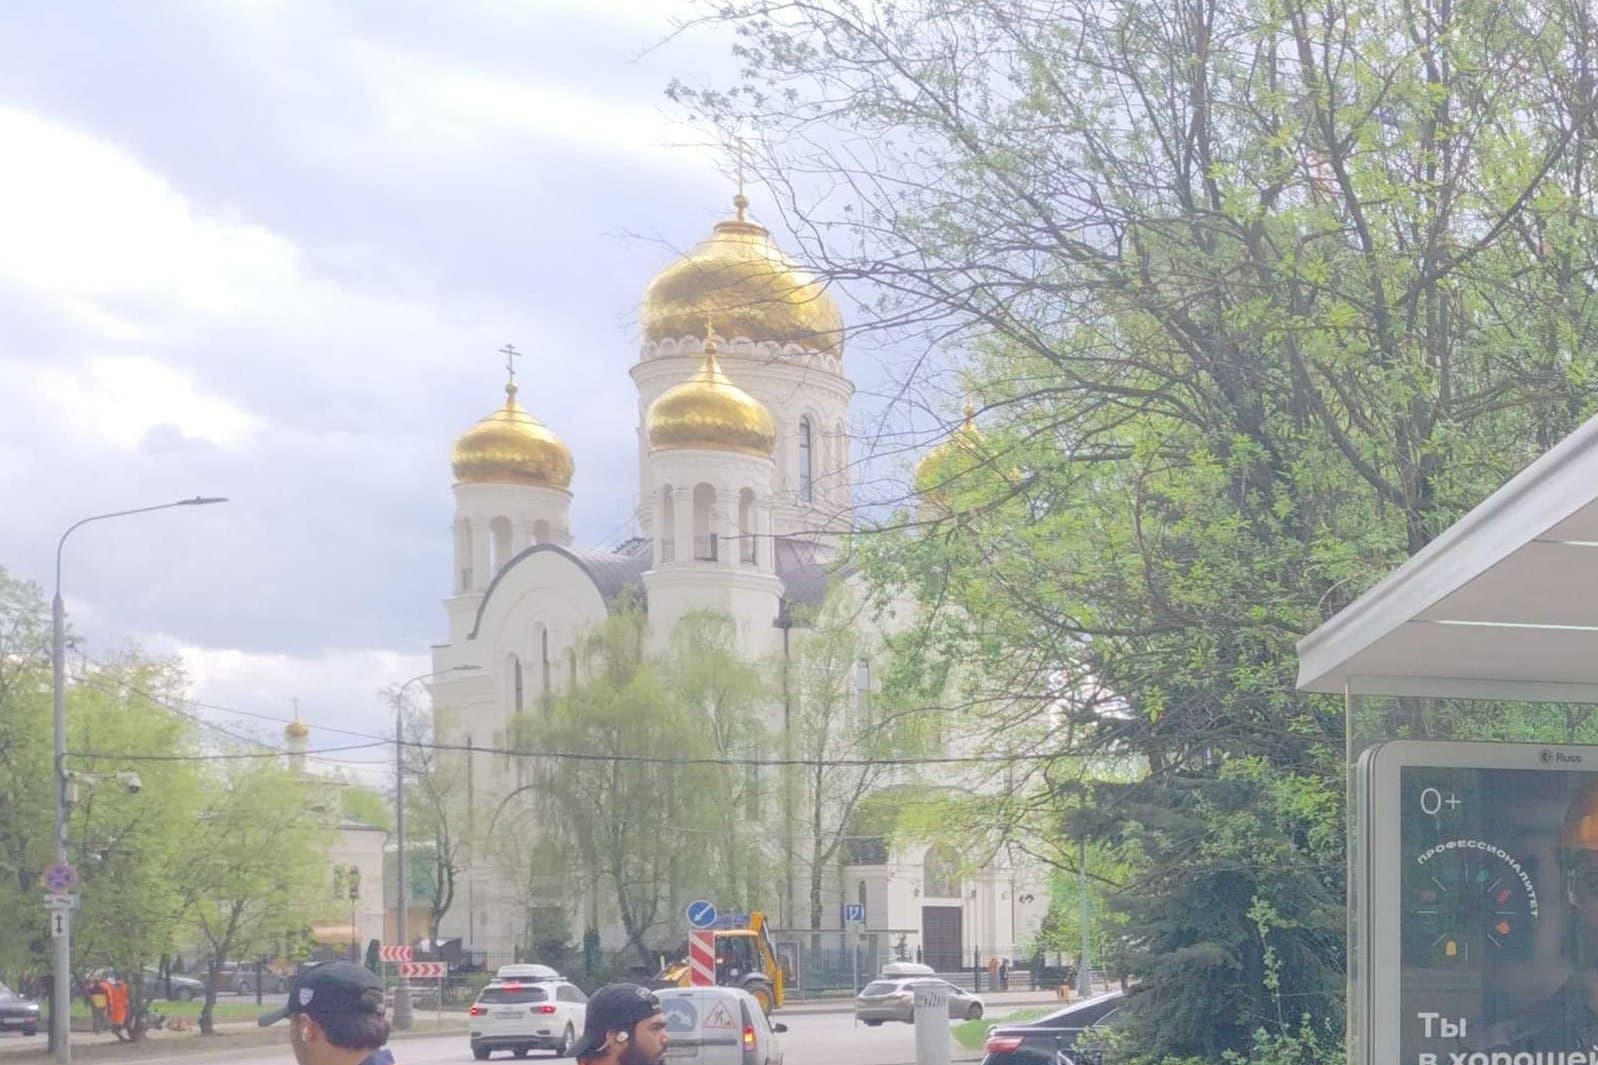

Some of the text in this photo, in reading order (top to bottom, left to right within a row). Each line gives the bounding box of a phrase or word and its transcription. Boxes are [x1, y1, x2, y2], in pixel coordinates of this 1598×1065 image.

[1420, 788, 1461, 814] 0+
[1417, 840, 1539, 919] ПРОФЕССИОНАЛИТЕТ
[1418, 1012, 1466, 1038] Ты
